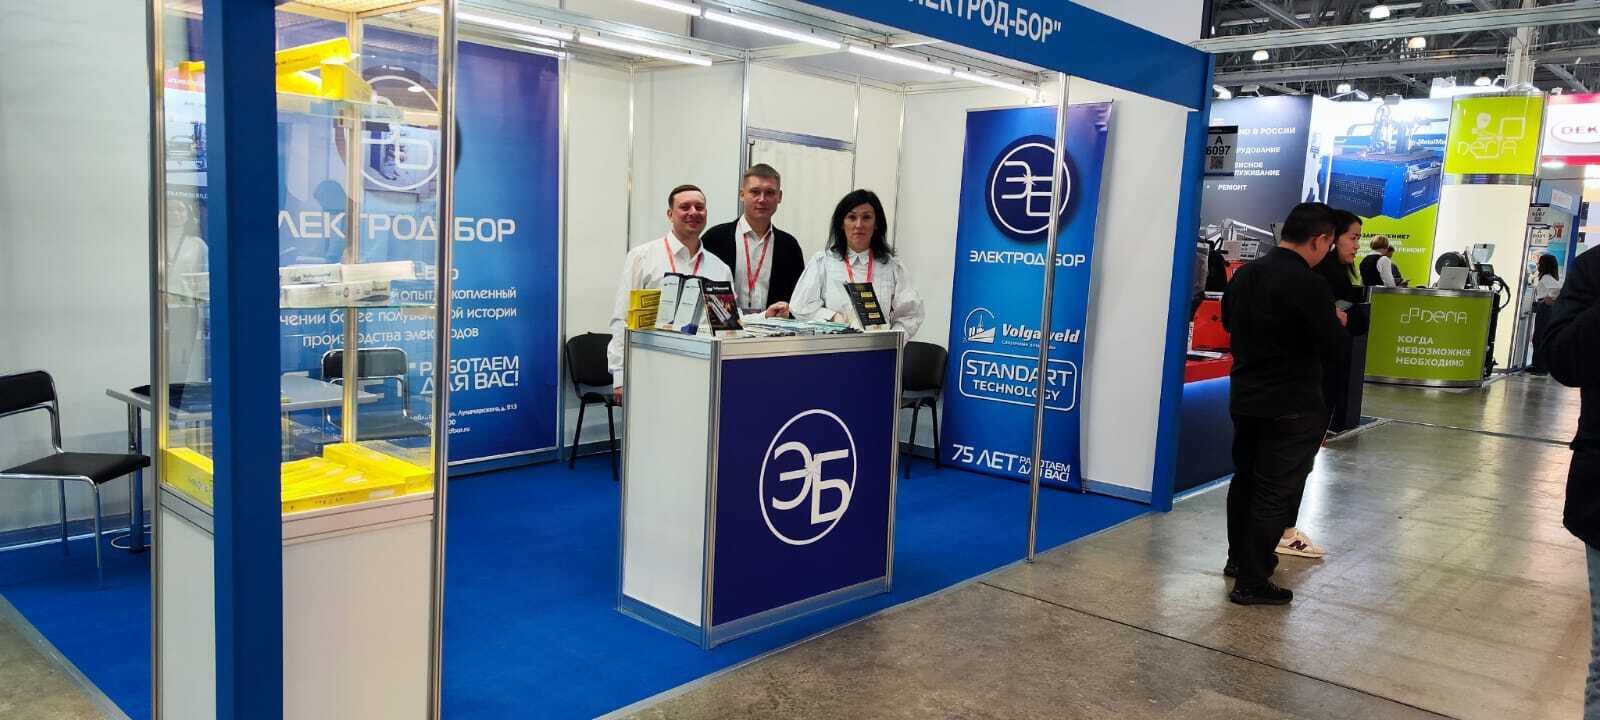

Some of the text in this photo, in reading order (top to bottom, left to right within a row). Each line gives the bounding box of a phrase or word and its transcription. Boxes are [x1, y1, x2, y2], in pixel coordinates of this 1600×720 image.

[451, 286, 517, 299] копленный
[279, 313, 325, 325] чении
[467, 308, 517, 319] истории
[303, 328, 479, 348] произодства элекодов
[1398, 335, 1434, 345] КОГДА
[420, 356, 519, 376] РБОТАЕМ
[1395, 357, 1464, 368] НЕОБХОДИМО
[420, 375, 469, 395] ДЯ
[475, 370, 519, 390] ВАС!
[952, 444, 1019, 471] 75 ЛЕТ
[1019, 456, 1071, 473] РАОТАЕМ
[772, 441, 851, 525] ЭБ
